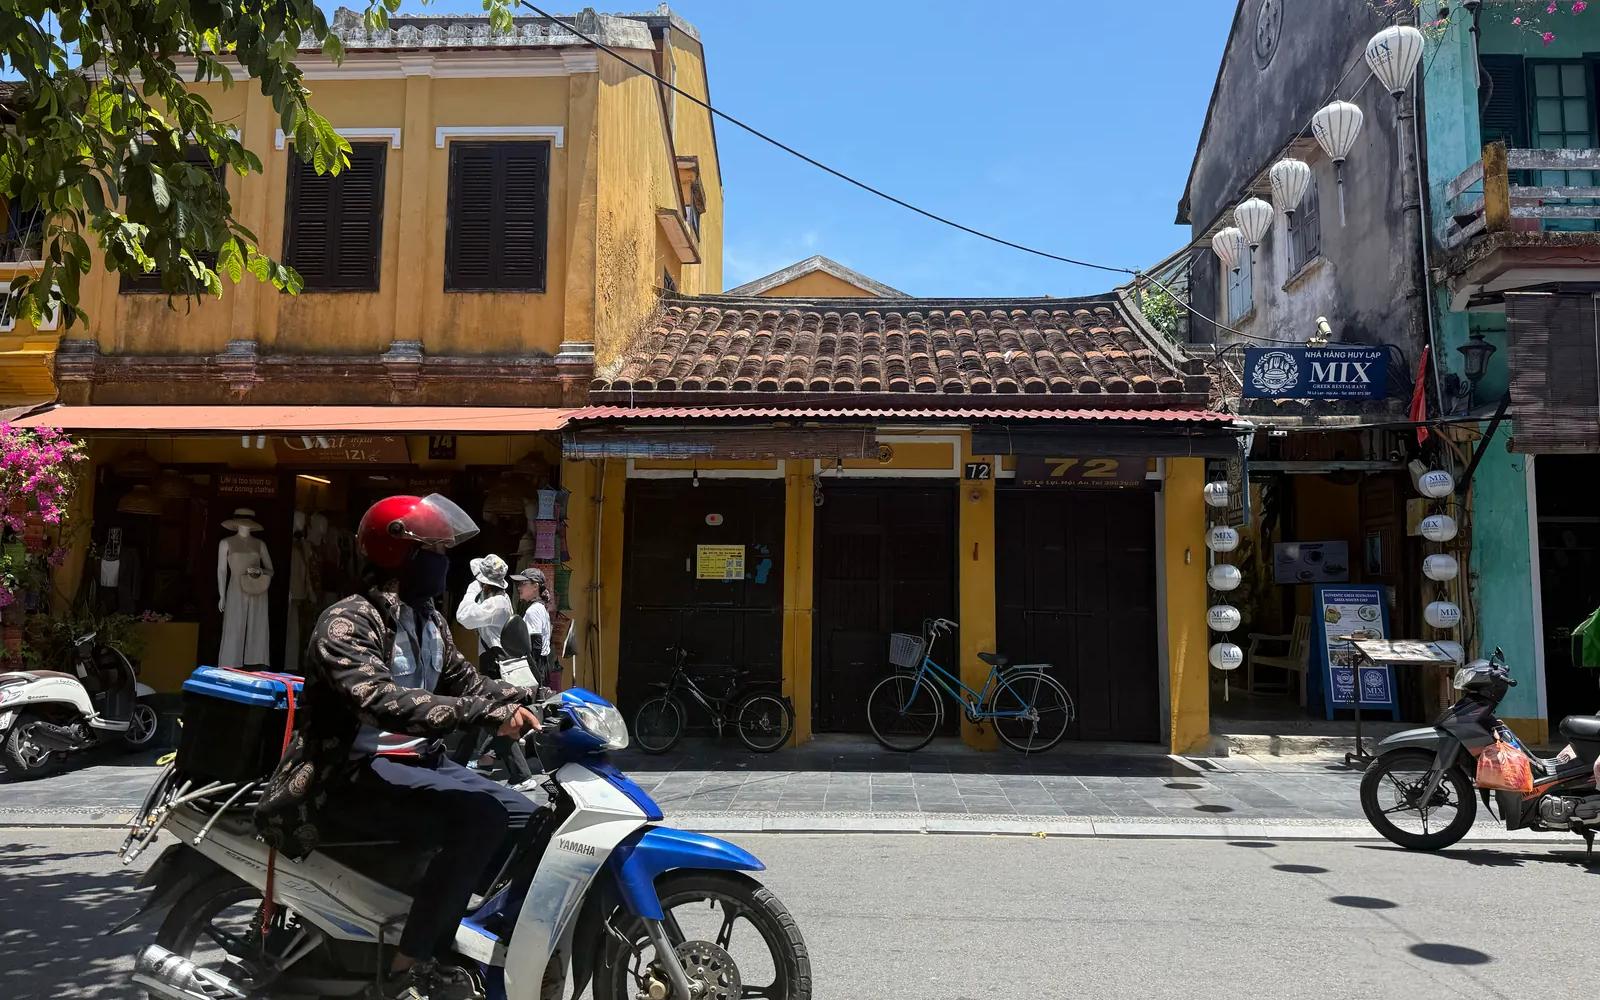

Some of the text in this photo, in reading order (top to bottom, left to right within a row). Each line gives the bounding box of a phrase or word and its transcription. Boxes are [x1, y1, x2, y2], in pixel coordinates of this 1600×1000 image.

[1309, 361, 1372, 383] MIX
[967, 464, 989, 479] 72
[1044, 458, 1120, 478] 72
[1429, 474, 1448, 482] MIX
[1211, 610, 1229, 618] MIX
[1440, 608, 1458, 616] MIX
[559, 838, 596, 857] YAMAHA
